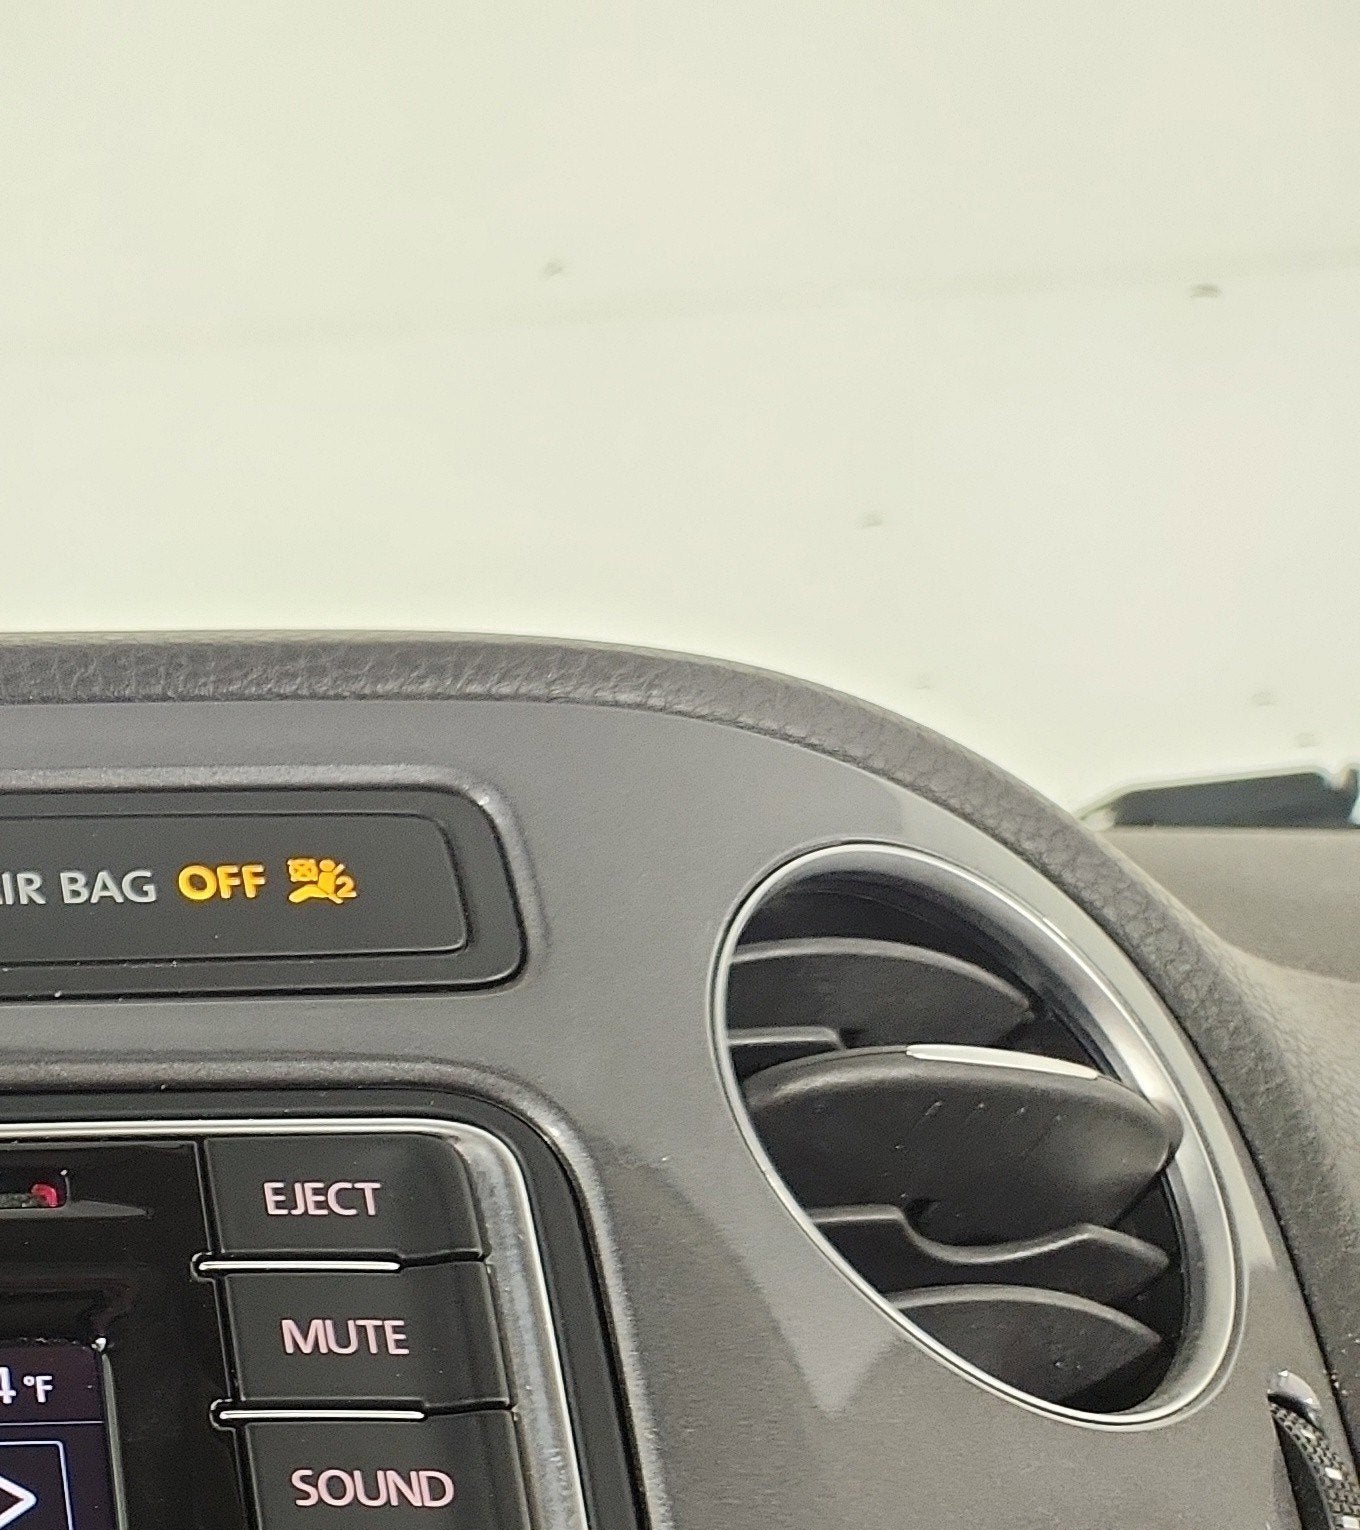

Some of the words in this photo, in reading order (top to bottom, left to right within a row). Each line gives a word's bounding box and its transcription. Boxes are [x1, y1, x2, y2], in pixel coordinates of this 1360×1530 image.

[59, 868, 158, 904] BAG
[178, 864, 266, 903] OFF
[263, 1181, 382, 1216] EJECT
[281, 1319, 410, 1355] MUTE
[291, 1469, 455, 1508] SOUND
